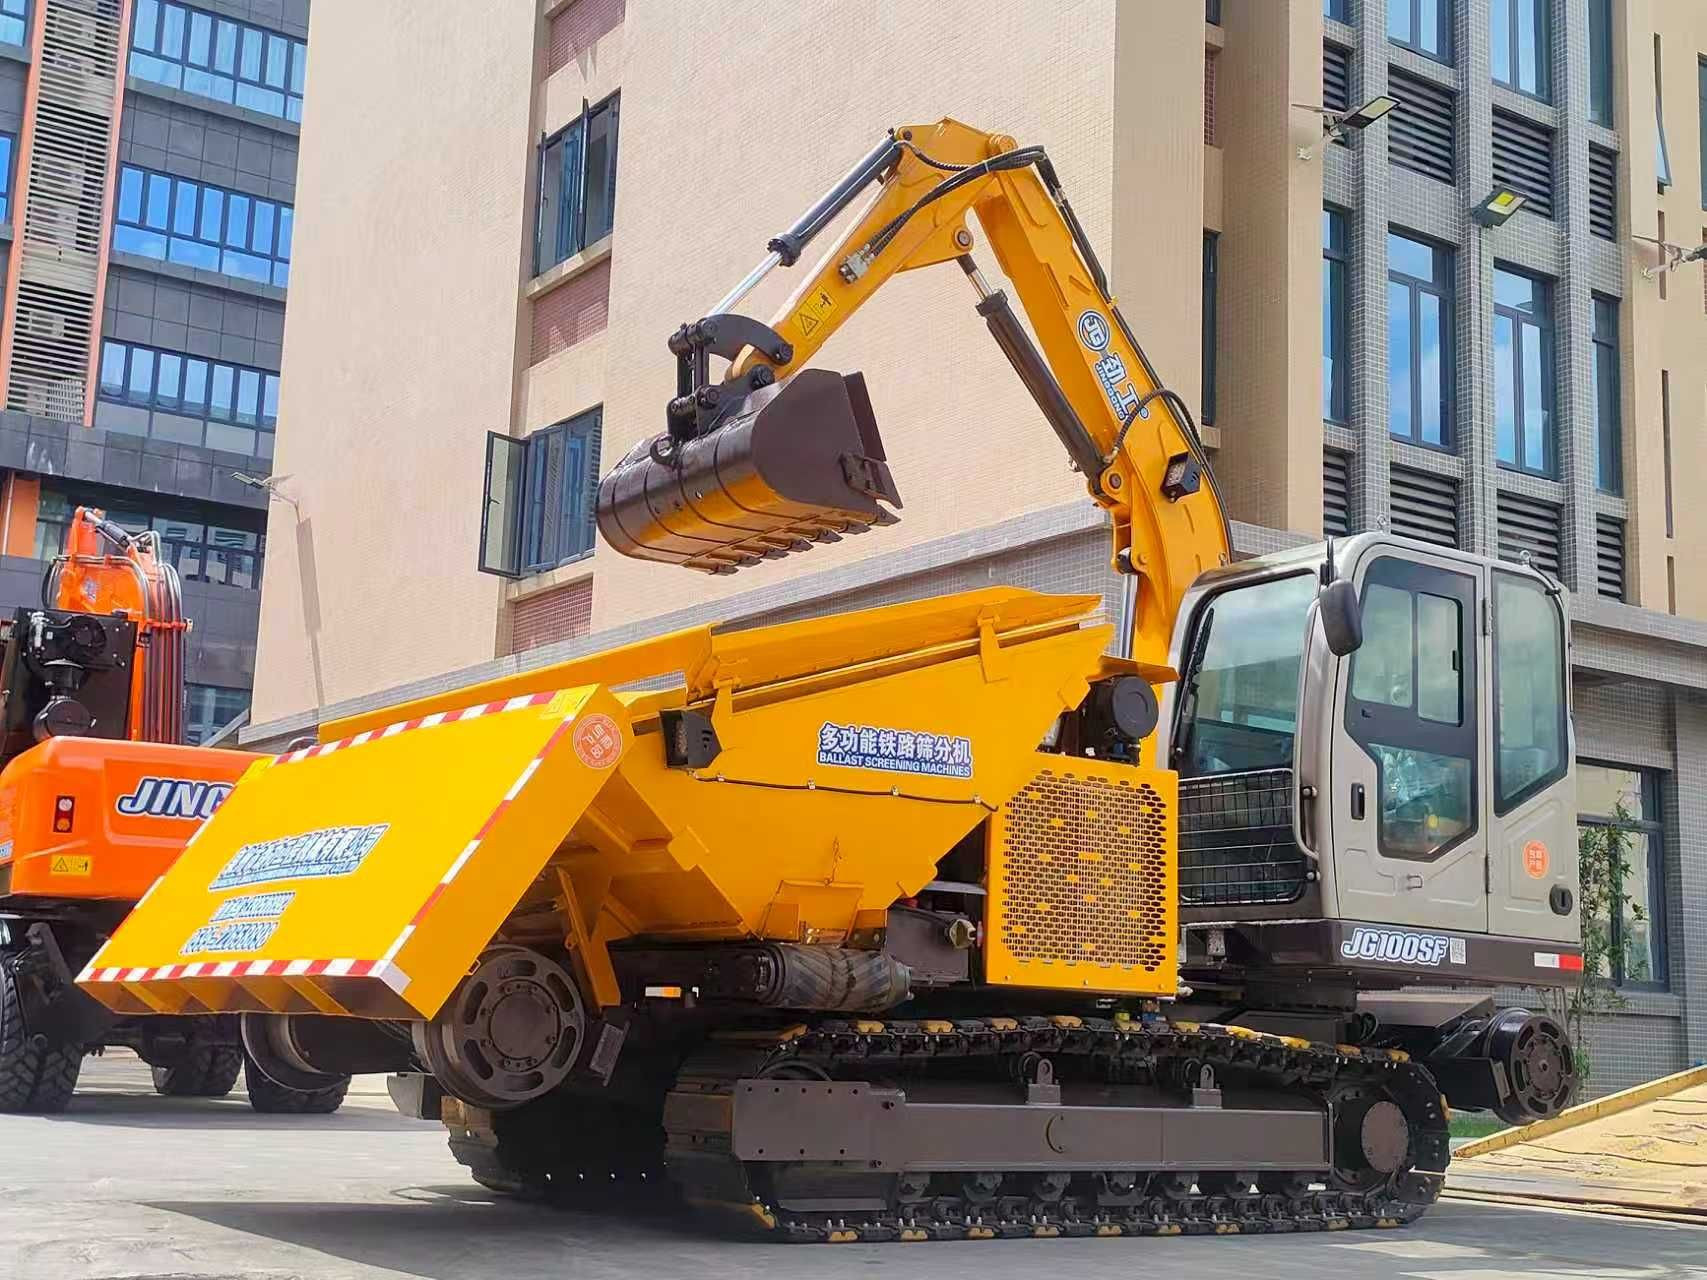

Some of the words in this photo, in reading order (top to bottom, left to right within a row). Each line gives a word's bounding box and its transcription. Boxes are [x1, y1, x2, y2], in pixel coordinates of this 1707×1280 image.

[821, 723, 970, 764] 多功能铁路筛分机
[819, 751, 863, 766] BALLAST
[865, 756, 920, 772] SCREENING
[921, 761, 970, 777] MACHINES
[1343, 930, 1448, 964] JG100SF
